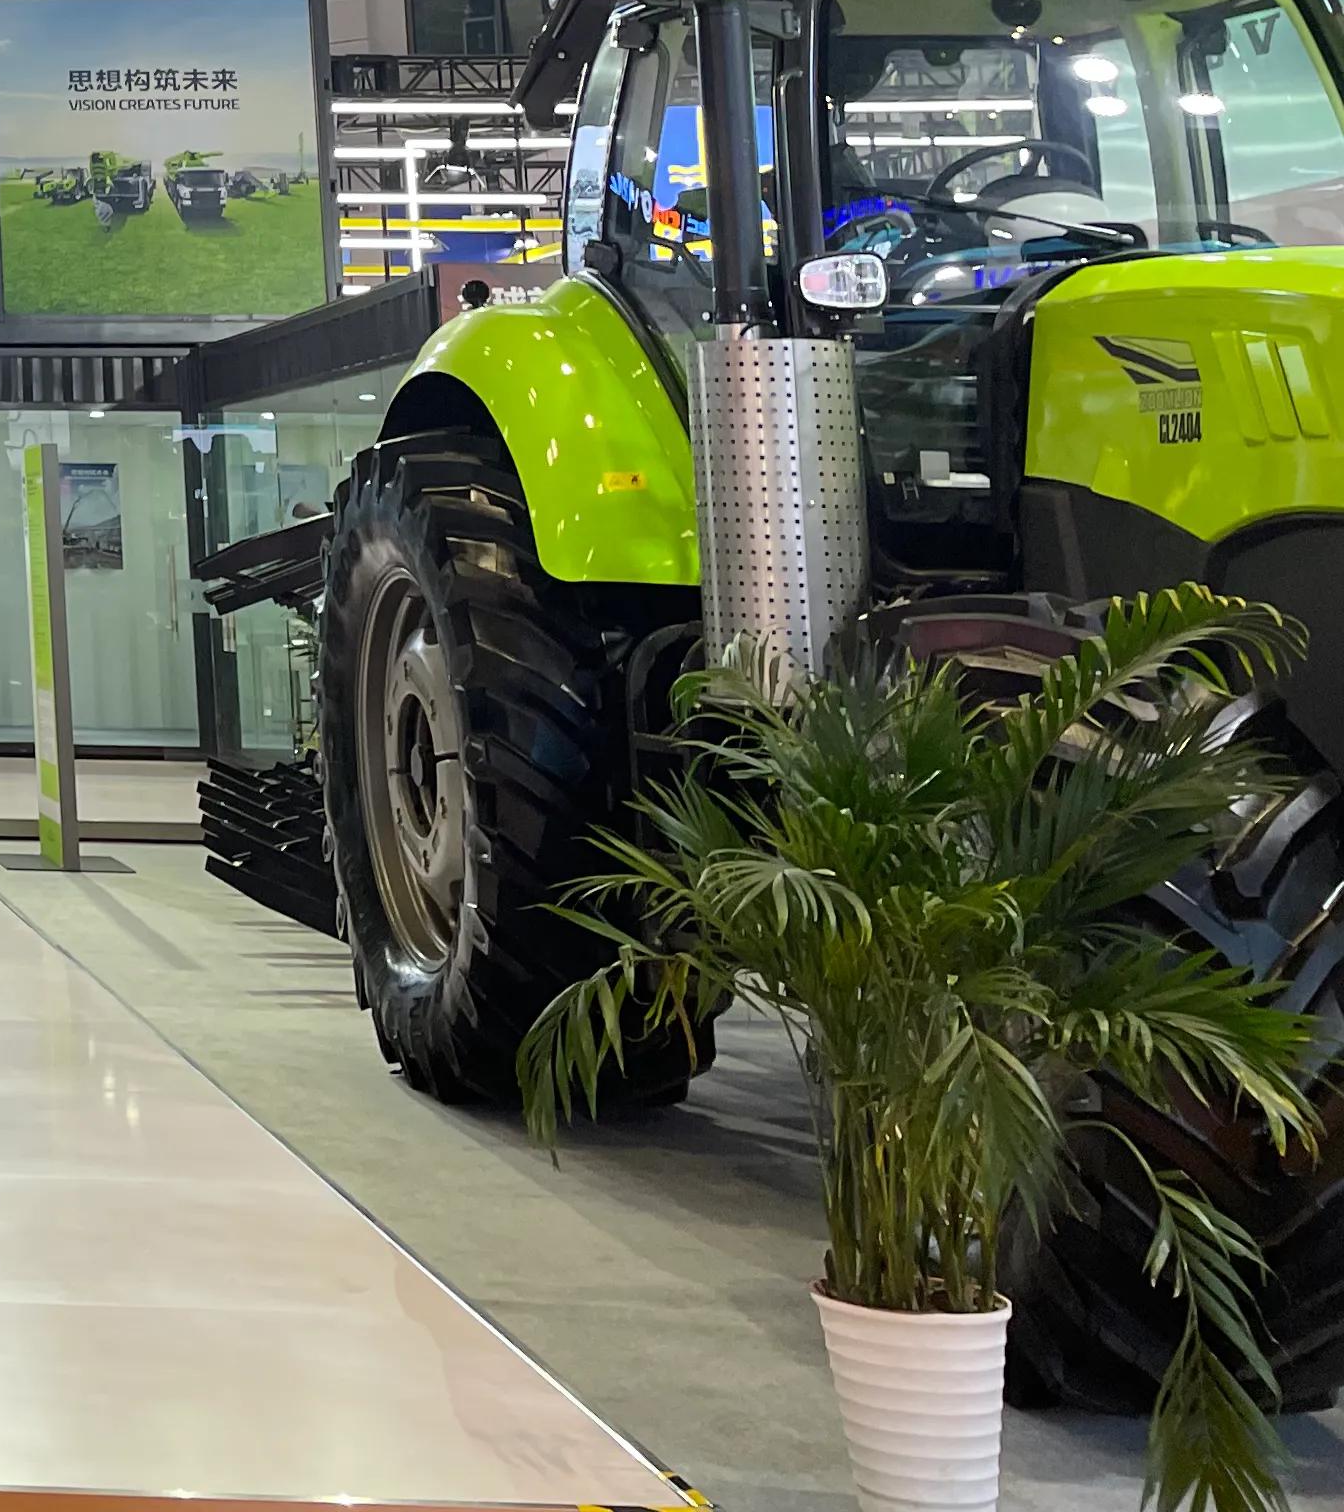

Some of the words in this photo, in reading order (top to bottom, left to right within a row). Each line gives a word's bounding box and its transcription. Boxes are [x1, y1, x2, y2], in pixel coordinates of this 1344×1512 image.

[68, 68, 239, 92] 思想构筑未来
[69, 99, 116, 111] VISION
[119, 99, 181, 110] CREATES
[184, 99, 240, 110] FUTURE
